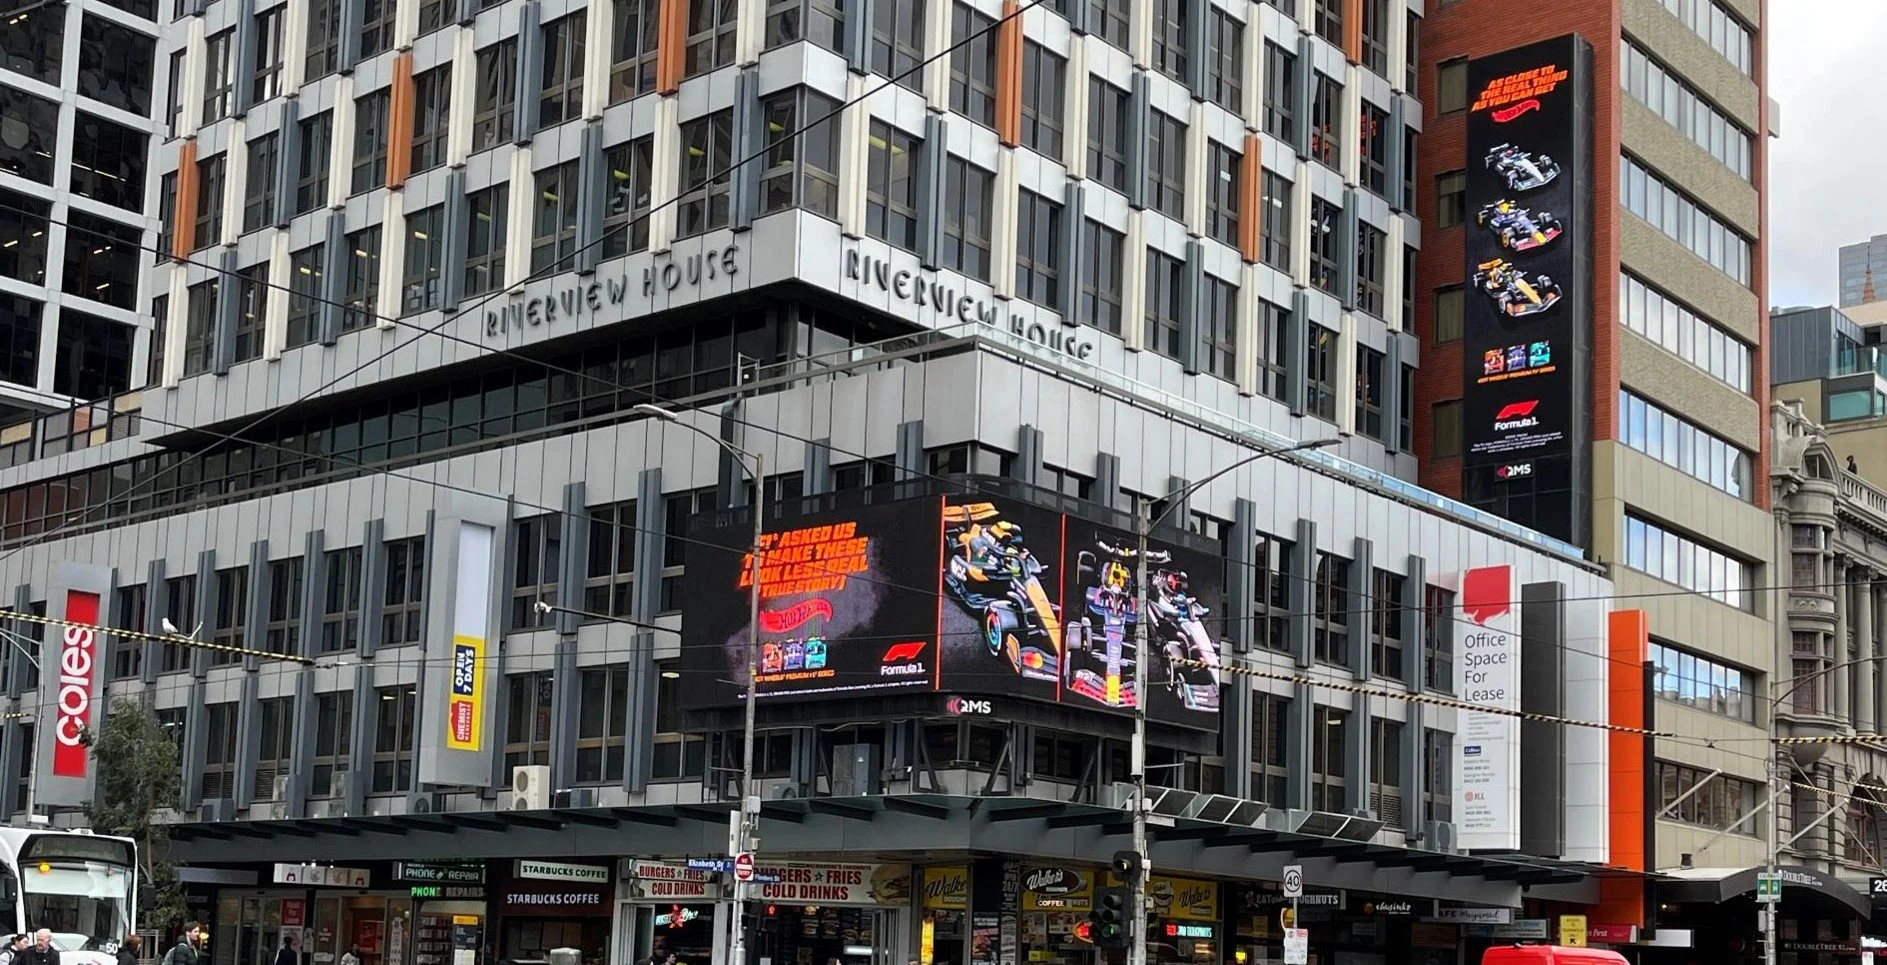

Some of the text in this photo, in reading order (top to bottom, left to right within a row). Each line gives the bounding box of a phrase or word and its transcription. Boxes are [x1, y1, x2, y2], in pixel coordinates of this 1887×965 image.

[1488, 64, 1555, 89] AS CLOSE TO
[1471, 100, 1488, 112] AS
[1489, 94, 1511, 107] YOU
[1511, 87, 1534, 101] CAN
[1481, 87, 1502, 99] THE
[487, 244, 740, 338] RIVERVIEW HOUSE
[847, 248, 1094, 361] RIVERVIEW HOUSE
[779, 525, 832, 547] ASKED
[833, 521, 857, 539] US
[766, 544, 814, 566] MAKE
[815, 536, 868, 559] THESE
[783, 560, 826, 580] LESS
[1465, 633, 1506, 648] Office
[1464, 652, 1507, 669] Space
[455, 652, 465, 687] OPEN
[463, 648, 474, 693] 7 DAYS
[1465, 670, 1488, 683] For
[56, 624, 93, 746] coles
[1465, 688, 1504, 702] Lease
[457, 702, 466, 740] CHEMIST
[688, 859, 716, 868] Elizabeth
[405, 868, 479, 880] PHONE REPAIR
[522, 865, 606, 879] STARBUCKS COFFEE
[639, 865, 704, 881] BURGERS FRIES
[826, 870, 862, 885] FRIES
[652, 882, 705, 895] COLD DRINKS
[1286, 875, 1300, 887] 40
[411, 886, 484, 898] PHONE REPAIRS
[507, 893, 600, 904] STARBUCKS COFFEE
[763, 884, 849, 900] COLD DRINKS
